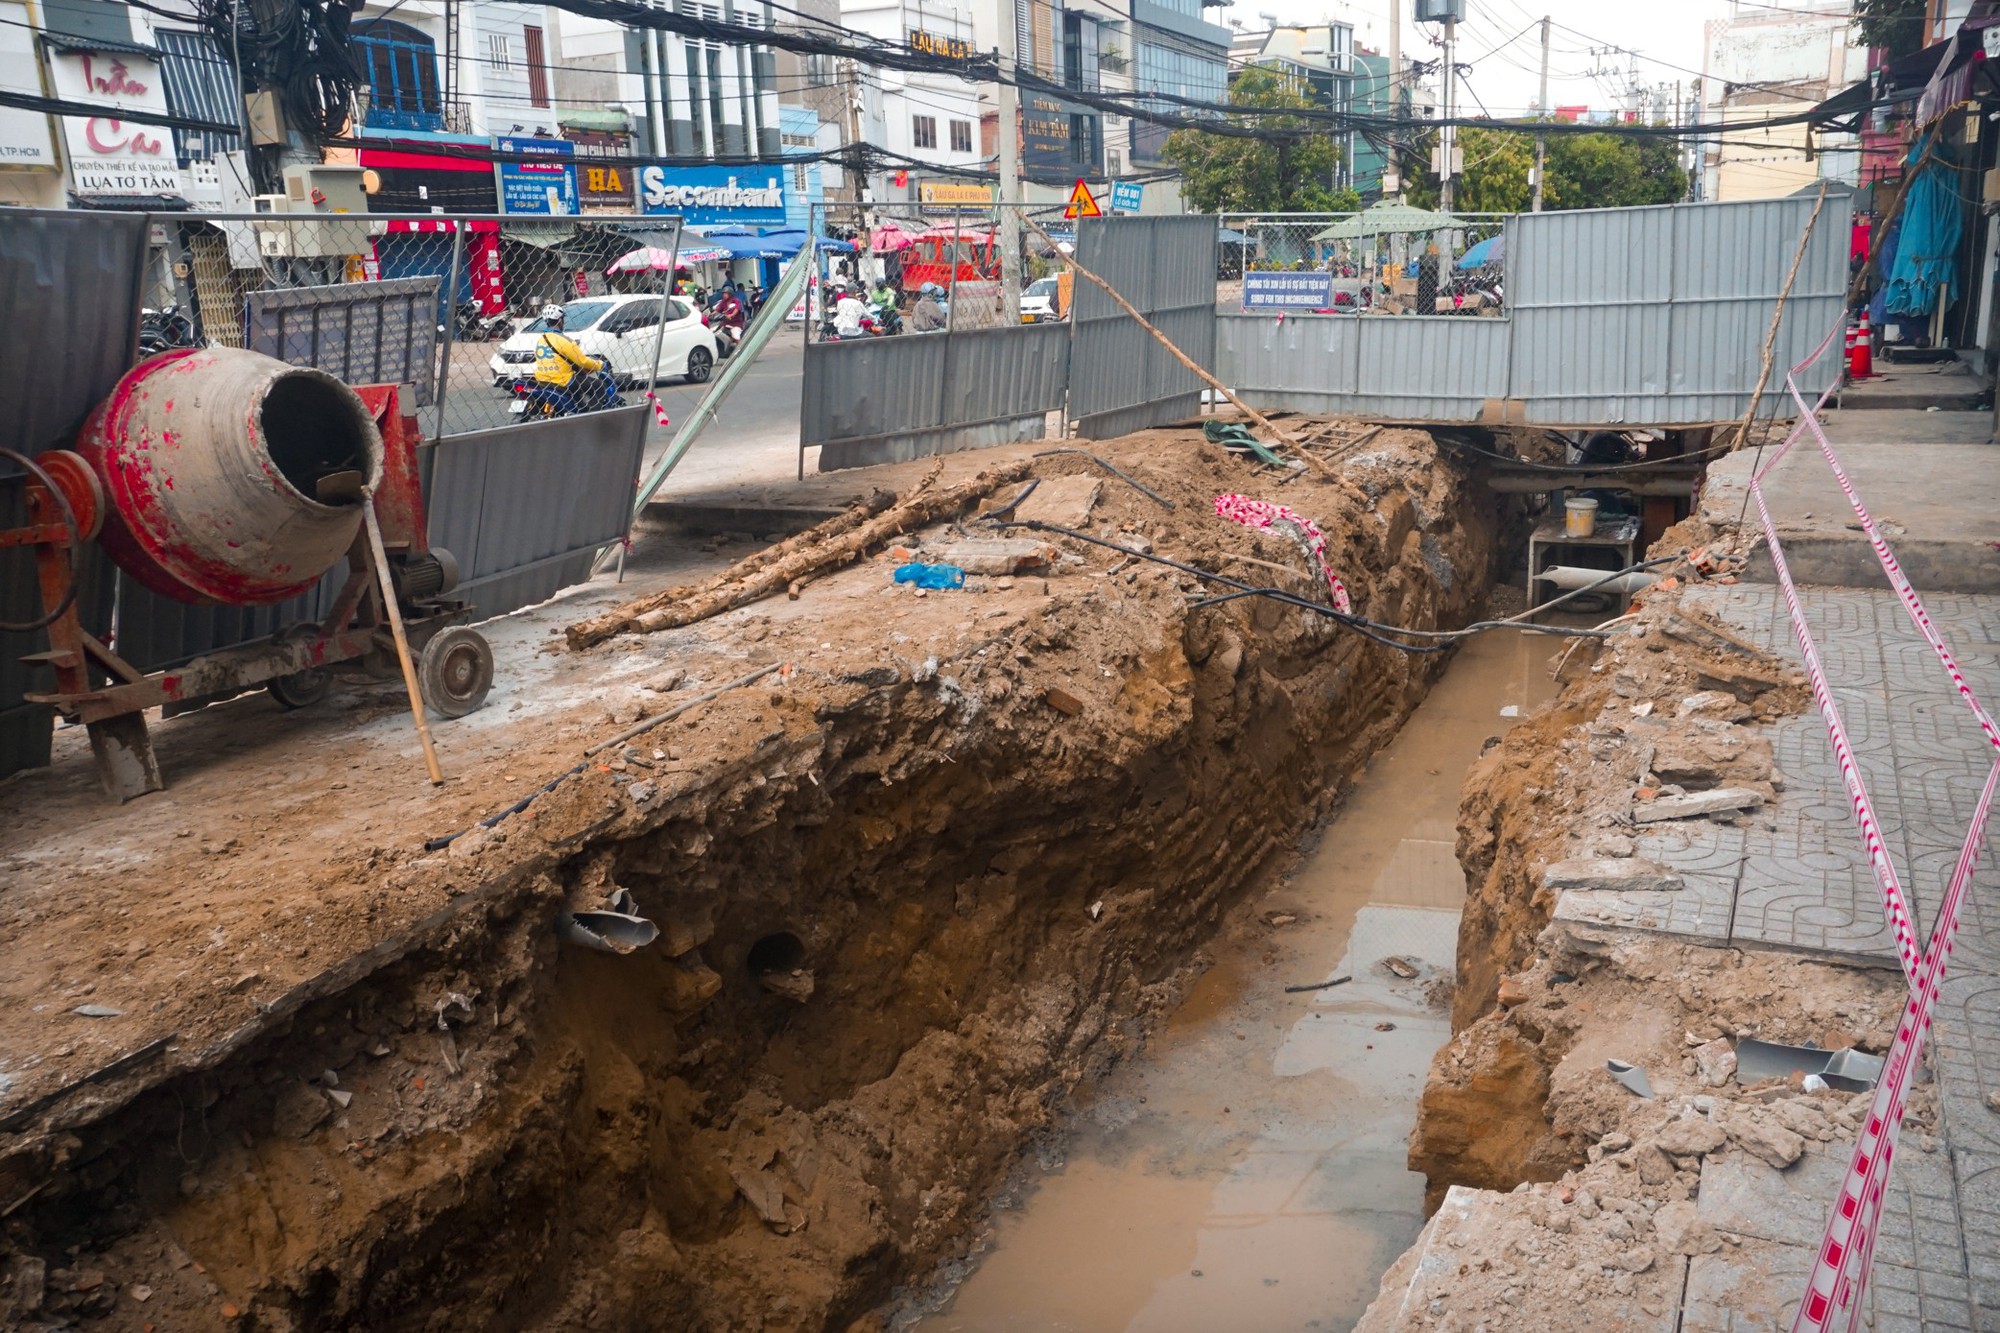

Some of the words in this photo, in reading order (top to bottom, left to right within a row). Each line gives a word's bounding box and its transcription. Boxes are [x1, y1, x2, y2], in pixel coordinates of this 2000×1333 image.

[82, 176, 112, 190] LỤA
[115, 175, 136, 188] TƠ
[642, 166, 783, 207] Sacombank
[1251, 294, 1264, 304] SORRY
[1265, 294, 1274, 304] FOR
[1274, 294, 1284, 304] THIS
